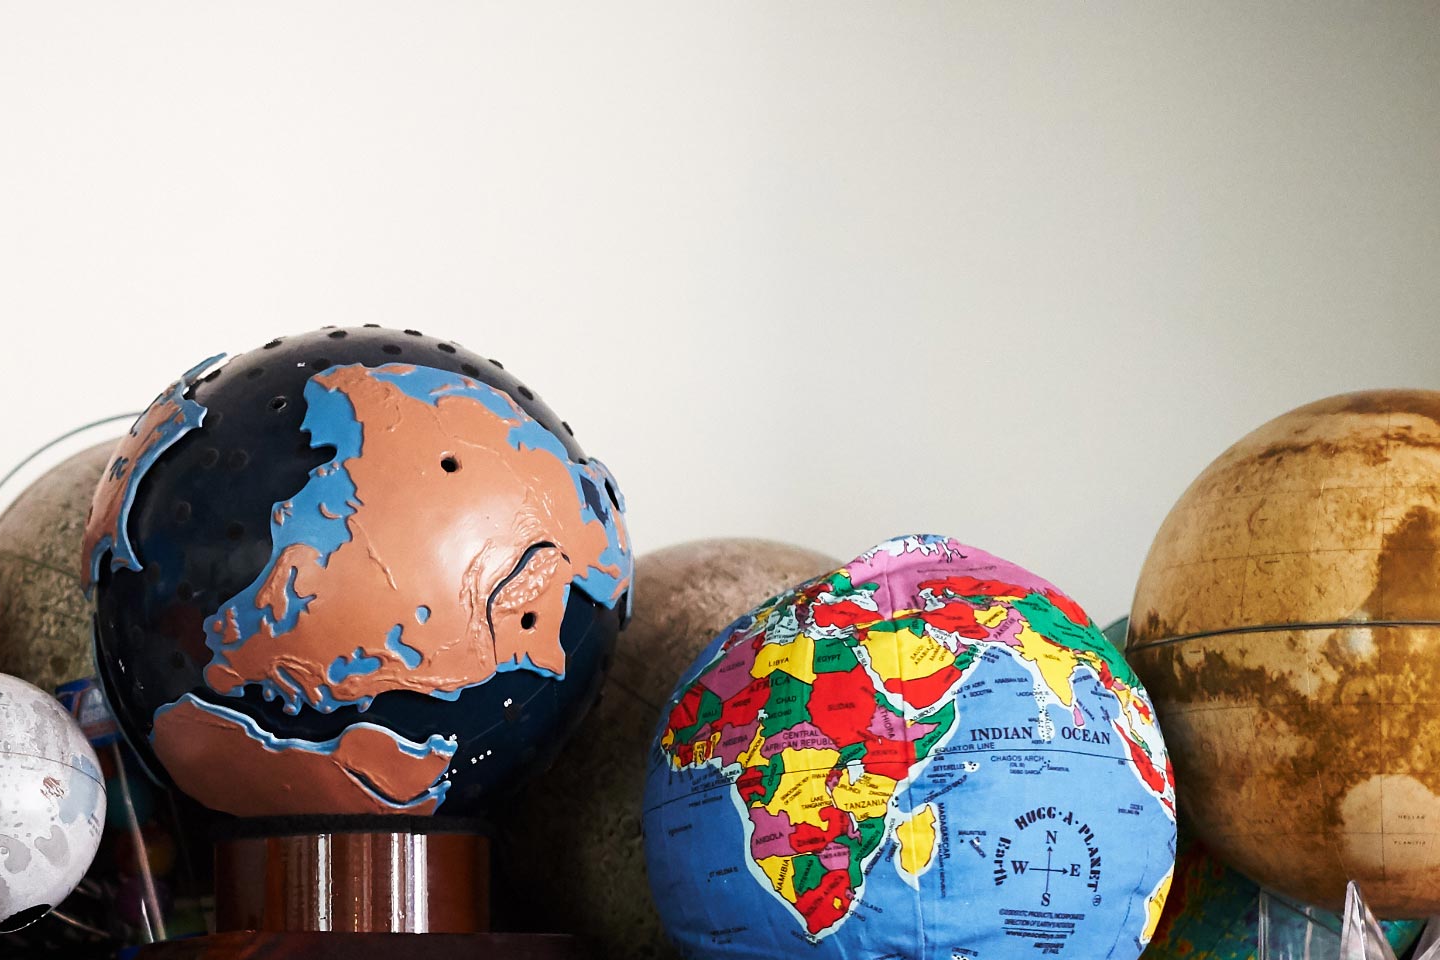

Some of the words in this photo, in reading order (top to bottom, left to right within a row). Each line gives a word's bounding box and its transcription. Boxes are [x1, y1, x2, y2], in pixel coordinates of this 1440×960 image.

[768, 657, 789, 667] LIBYA
[817, 654, 842, 663] EGYPT
[749, 676, 791, 693] AFRICA
[503, 698, 513, 707] 60
[776, 696, 797, 704] CHAD
[783, 730, 819, 740] CENTRAL
[970, 726, 1033, 742] INDIAN
[1061, 726, 1110, 745] OCEAN
[765, 740, 798, 752] AFRICAN
[934, 744, 974, 754] EQUATOR
[471, 750, 492, 765] Sea
[844, 799, 887, 810] TANZANIA
[937, 802, 951, 859] MADAGASCAR
[1046, 830, 1058, 844] N
[755, 832, 784, 845] ANGOLA
[994, 837, 1012, 886] Earth
[1011, 860, 1029, 875] W
[1069, 864, 1081, 877] E
[776, 859, 789, 892] NAMIBIA
[1040, 892, 1051, 907] S
[1004, 918, 1029, 926] DIRECTION
